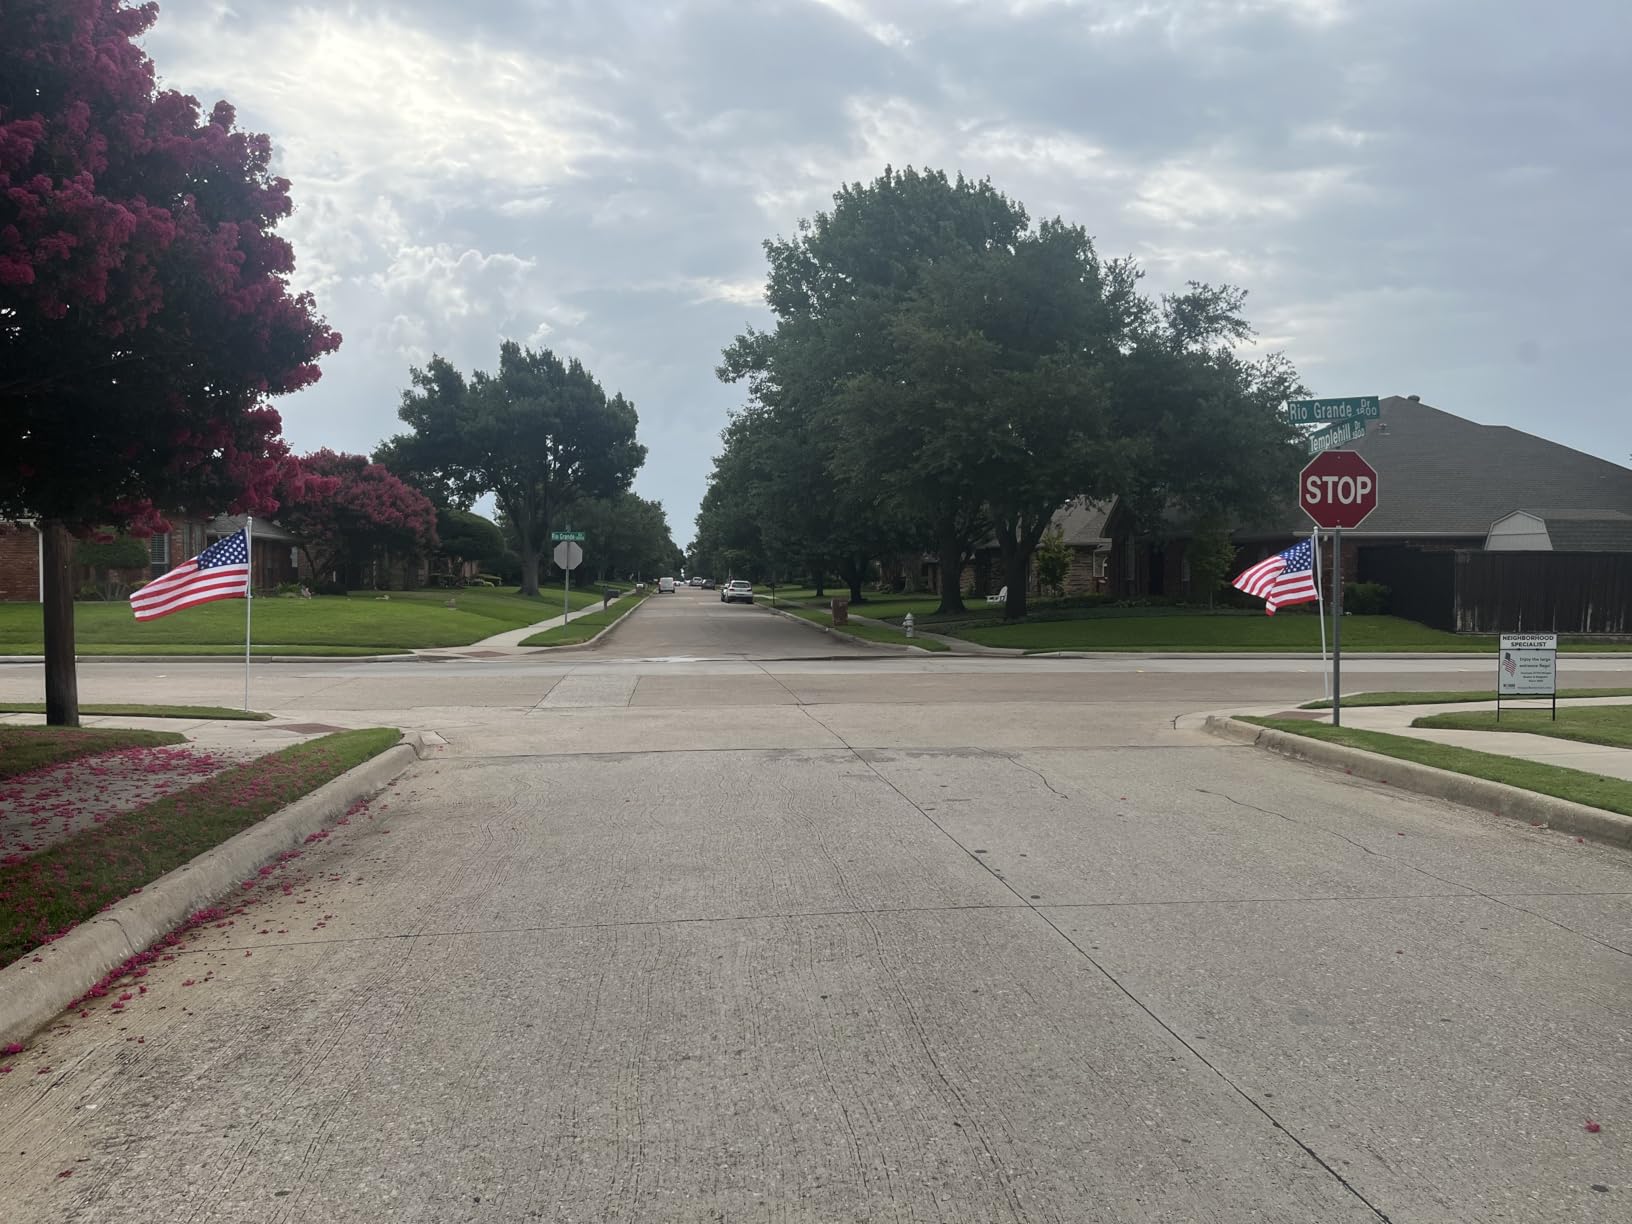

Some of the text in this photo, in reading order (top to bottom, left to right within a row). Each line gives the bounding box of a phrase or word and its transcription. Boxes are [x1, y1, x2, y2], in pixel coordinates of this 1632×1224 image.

[1290, 402, 1353, 420] Rio Grande
[1360, 398, 1371, 408] Dr
[1354, 420, 1361, 429] Dr
[1310, 423, 1351, 451] Templehill
[1305, 475, 1372, 505] STOP
